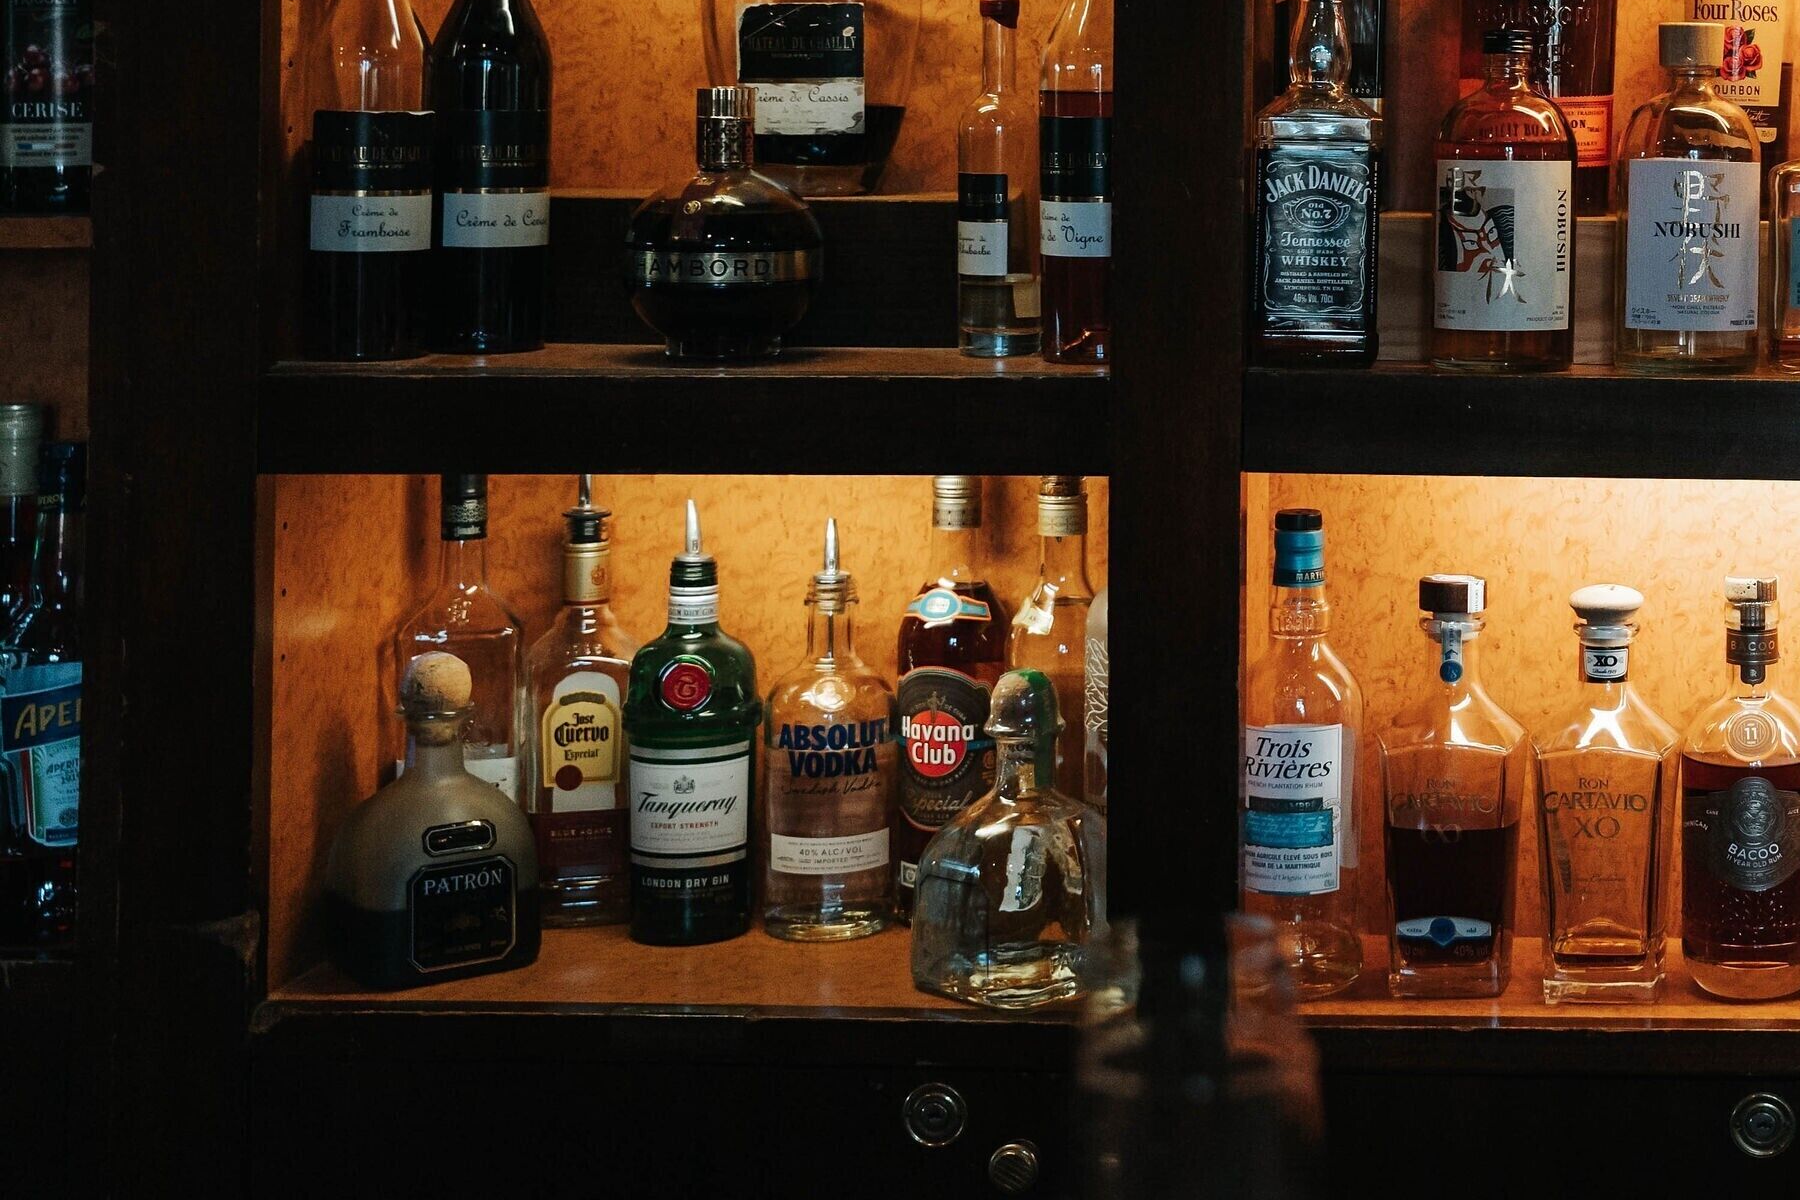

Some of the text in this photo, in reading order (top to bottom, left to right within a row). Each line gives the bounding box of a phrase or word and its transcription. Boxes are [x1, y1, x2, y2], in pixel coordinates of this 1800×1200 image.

[1693, 0, 1778, 22] Four Roses
[808, 86, 849, 103] Cassis
[1714, 85, 1760, 96] OURBON
[11, 101, 84, 119] CERISE
[1265, 165, 1372, 205] JACK DANIEL'S
[456, 210, 516, 227] Crème de
[1300, 208, 1332, 220] No.7
[338, 219, 411, 238] Framboise
[1061, 225, 1104, 249] Vigne
[1556, 190, 1568, 272] NOBUSHI
[1653, 221, 1741, 239] NOBUSHI
[1281, 231, 1352, 248] Tennessee
[1281, 256, 1350, 267] WHISKEY
[1729, 639, 1776, 652] BACOO
[1593, 655, 1618, 666] XO
[572, 712, 595, 726] Jose
[554, 722, 609, 747] Cuervo
[779, 717, 886, 751] ABSOLUT
[902, 715, 975, 742] Havana
[911, 741, 957, 765] Club
[1255, 736, 1313, 759] Trois
[788, 747, 878, 779] VODKA
[1245, 756, 1332, 779] Rivières
[1426, 779, 1456, 789] RON
[1578, 777, 1609, 789] RON
[637, 791, 738, 820] Tanqueray
[1392, 791, 1497, 813] CARTAVIO
[1543, 791, 1648, 814] CARTAVIO
[651, 820, 719, 829] EXPORT STRENGTH
[1572, 815, 1621, 839] XO
[799, 847, 818, 856] 40%
[1728, 843, 1780, 861] BACOO
[1733, 853, 1783, 868] YEAR OLD RUM
[1285, 862, 1321, 870] MARTINIQUE
[422, 867, 504, 897] PATRÓN
[642, 874, 730, 888] LONDON DRY GIN
